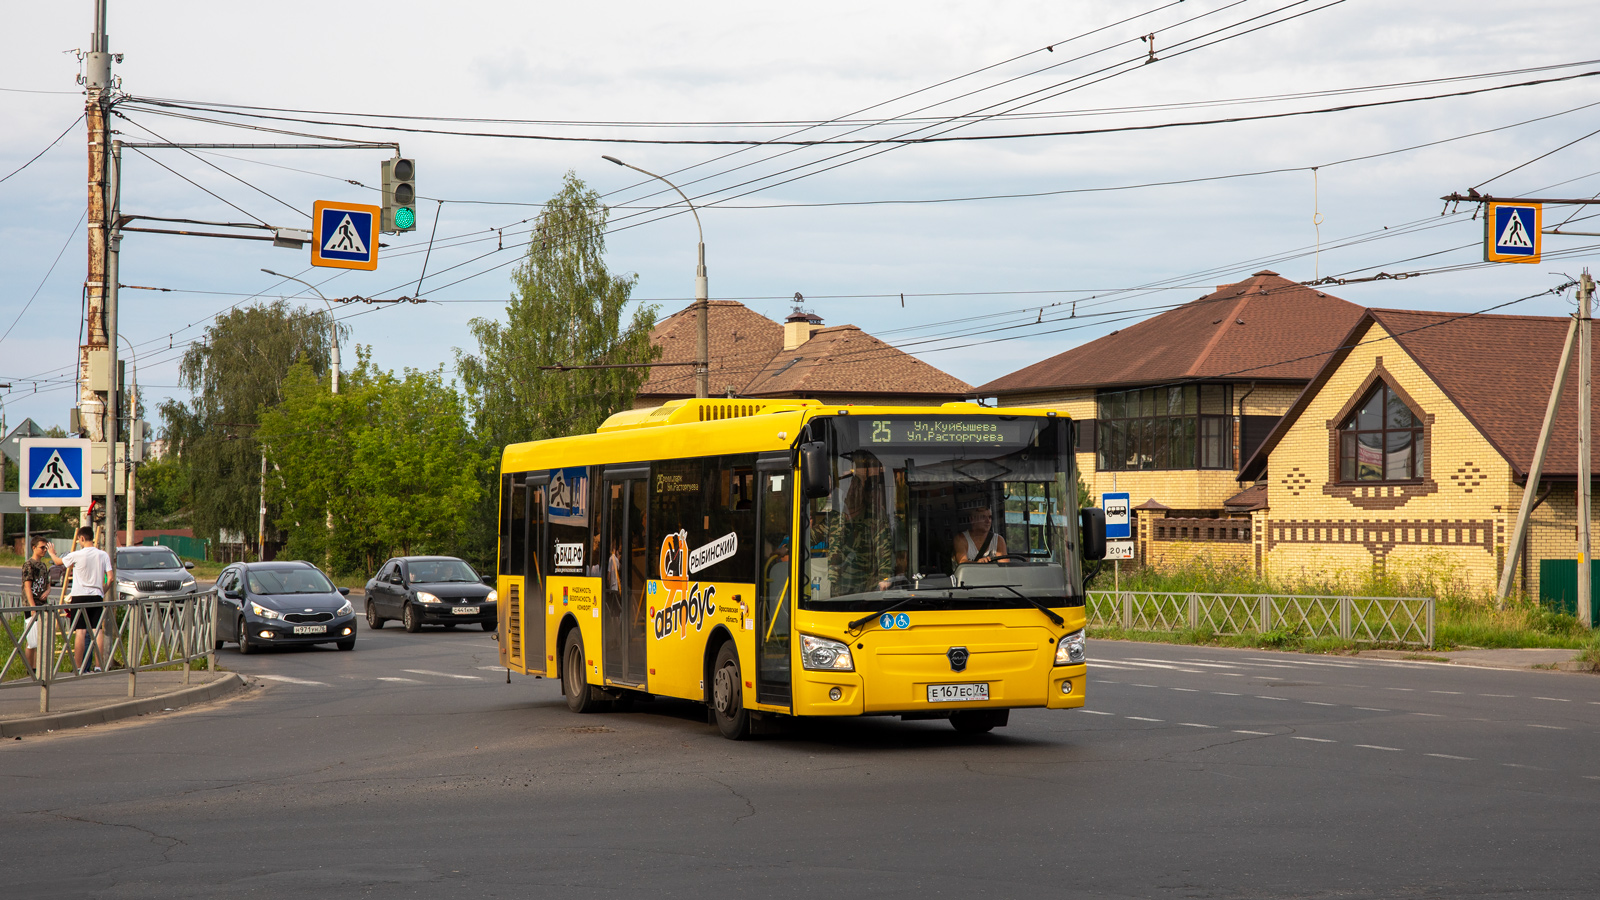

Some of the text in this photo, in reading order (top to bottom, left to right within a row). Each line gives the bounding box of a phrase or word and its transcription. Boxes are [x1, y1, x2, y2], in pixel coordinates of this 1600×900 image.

[872, 420, 891, 443] 25
[907, 431, 1004, 443] Ул.Расторгуева
[914, 421, 997, 433] Ул.Куйбышева
[559, 546, 583, 565] БКД.РФ
[690, 535, 736, 570] РЫБИНСКИЙ
[654, 581, 716, 640] автобус
